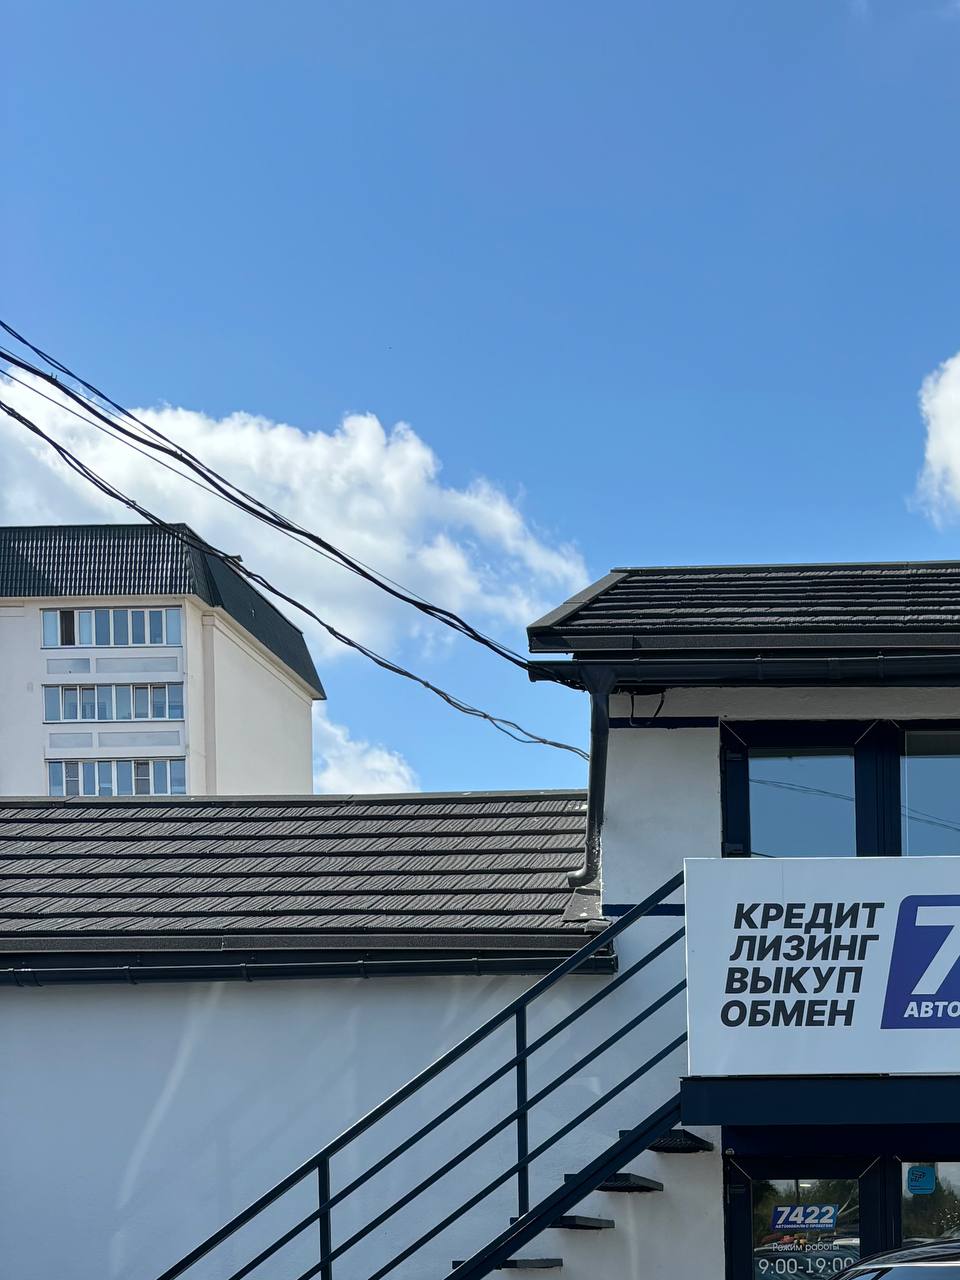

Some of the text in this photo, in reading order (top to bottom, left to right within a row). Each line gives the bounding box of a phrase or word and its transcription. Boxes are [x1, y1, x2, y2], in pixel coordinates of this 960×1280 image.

[734, 903, 885, 934] КРЕДИТ
[729, 935, 879, 961] ЛИЗИНГ
[725, 967, 863, 994] ВЫКУП
[721, 1000, 855, 1027] ОБМЕН
[776, 1206, 835, 1225] 7422
[772, 1241, 840, 1252] Режим работы
